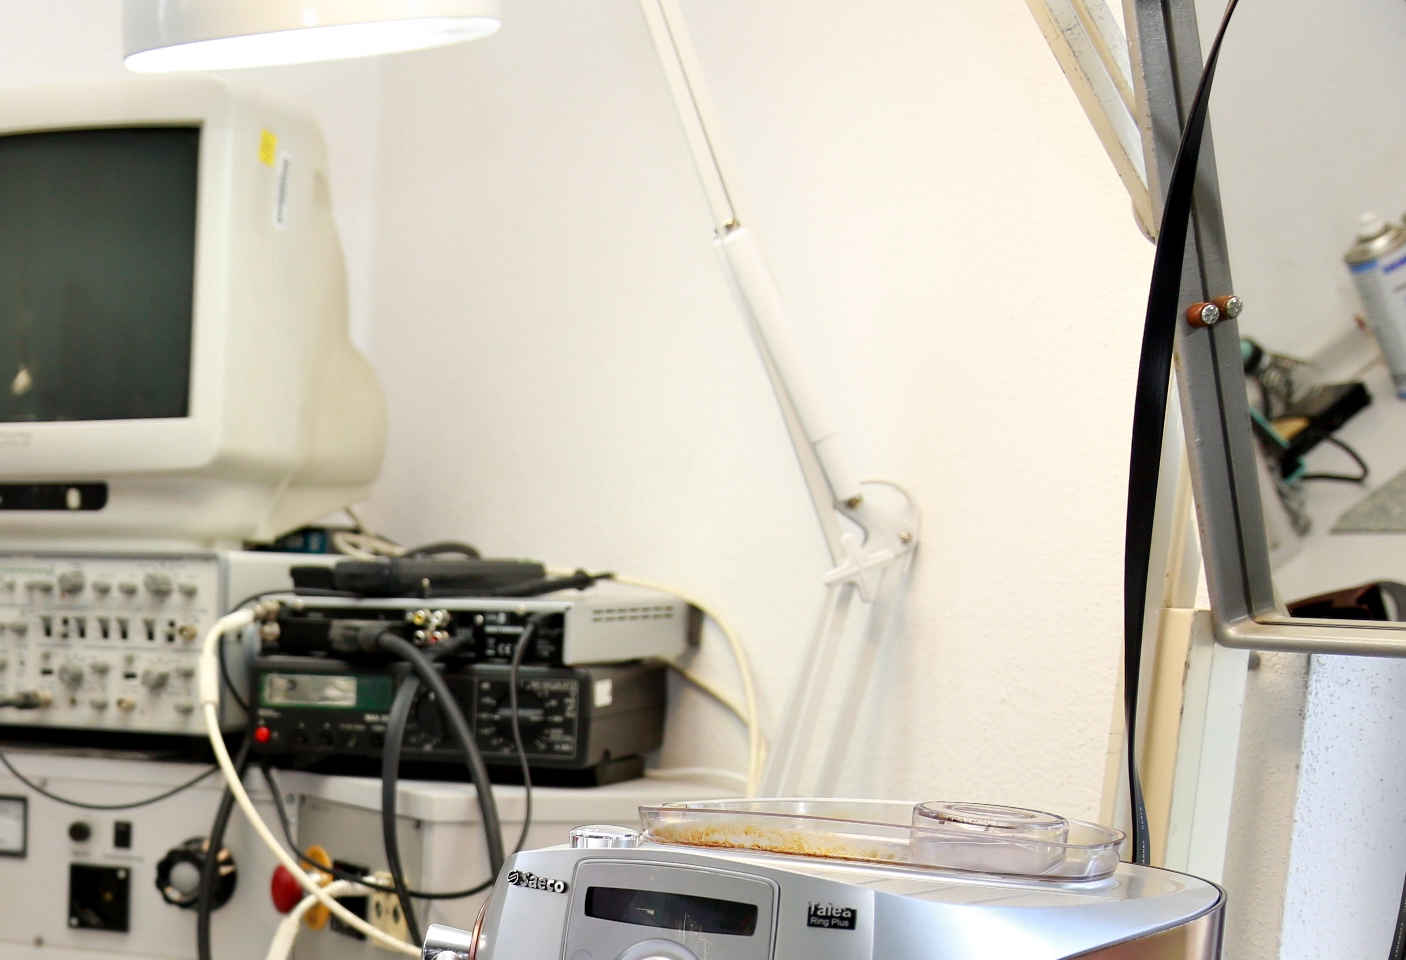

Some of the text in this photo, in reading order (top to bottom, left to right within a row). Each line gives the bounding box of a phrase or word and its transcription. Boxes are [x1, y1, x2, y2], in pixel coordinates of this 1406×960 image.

[519, 872, 566, 893] Saeco
[808, 902, 852, 918] Talea
[810, 916, 850, 927] Ring Plus
